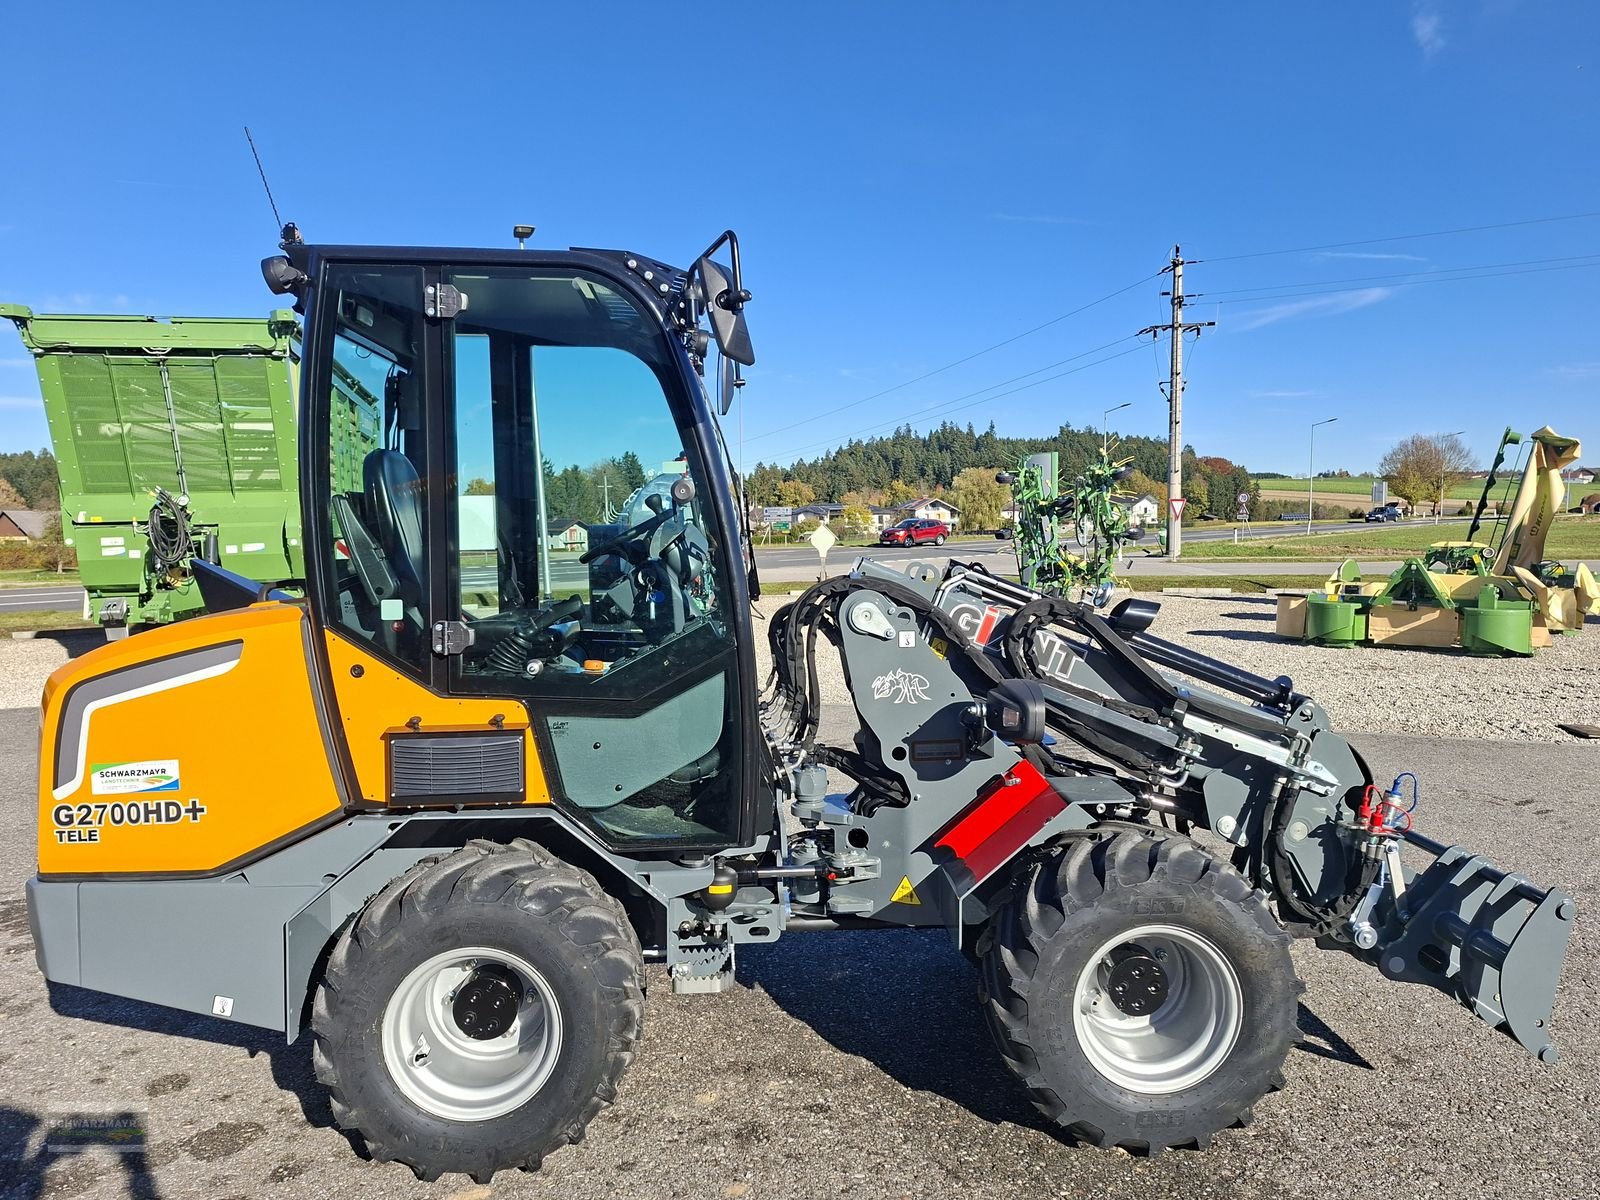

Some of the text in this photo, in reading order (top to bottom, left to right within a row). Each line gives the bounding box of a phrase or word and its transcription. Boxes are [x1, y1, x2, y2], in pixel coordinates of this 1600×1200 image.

[99, 768, 167, 778] SCHWARZMAYR
[53, 800, 206, 827] G2700HD+
[55, 829, 99, 843] TELE
